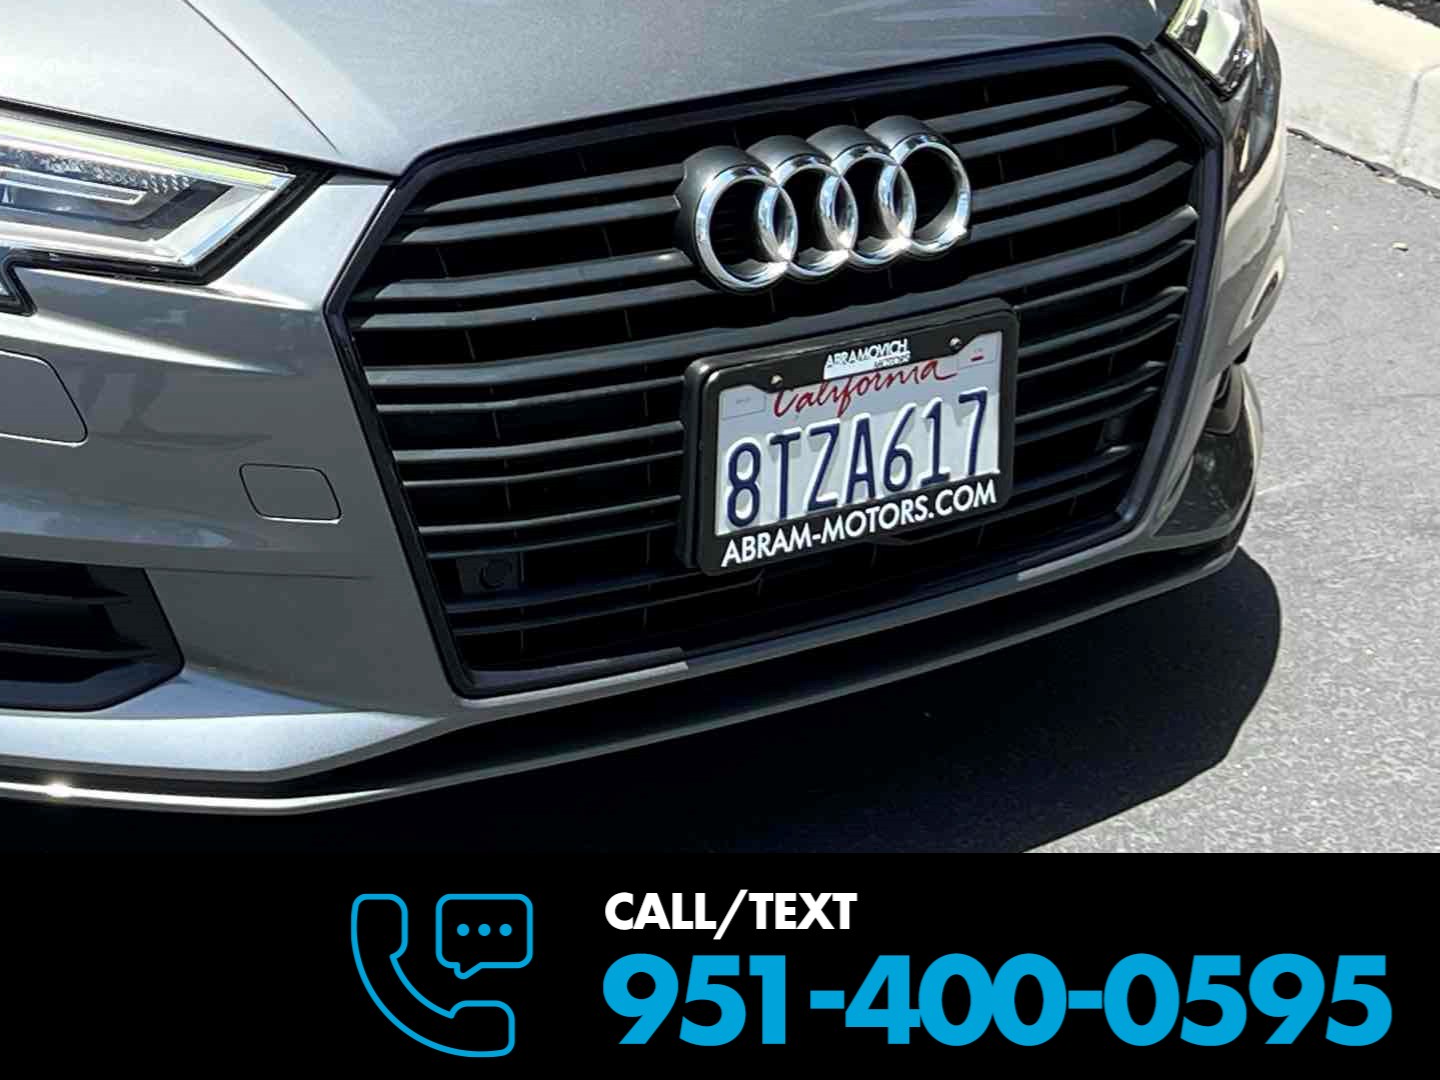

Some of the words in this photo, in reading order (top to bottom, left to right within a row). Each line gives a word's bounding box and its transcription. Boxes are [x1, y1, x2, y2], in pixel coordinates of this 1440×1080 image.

[773, 359, 958, 418] California
[824, 338, 910, 369] ABRAMOVICH
[726, 386, 989, 527] 8TZA617
[720, 479, 998, 568] ABRAM-MOTORS.COM
